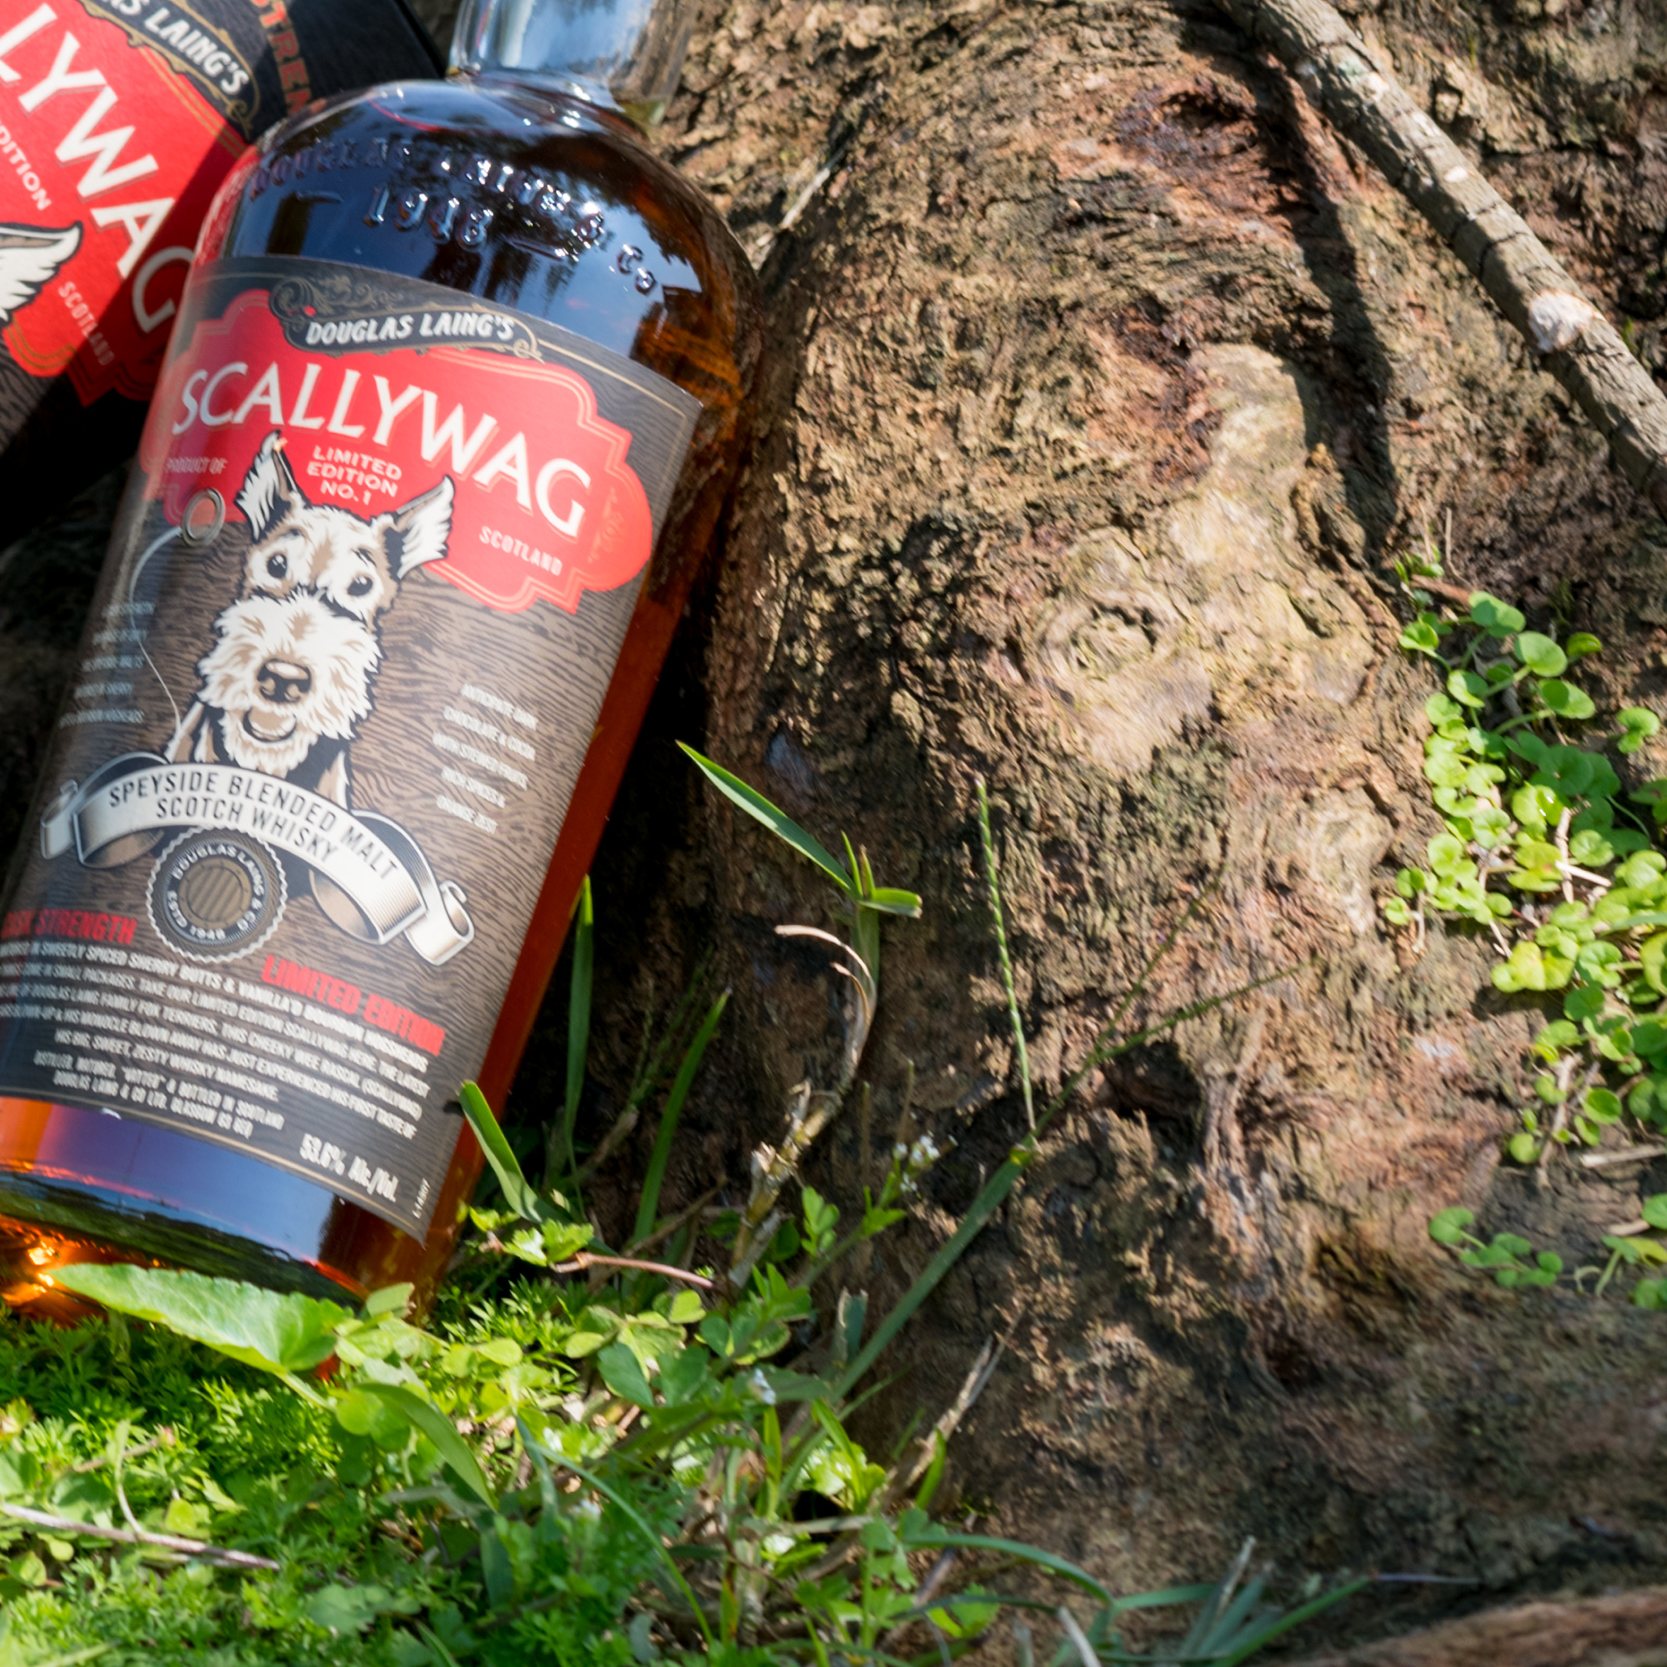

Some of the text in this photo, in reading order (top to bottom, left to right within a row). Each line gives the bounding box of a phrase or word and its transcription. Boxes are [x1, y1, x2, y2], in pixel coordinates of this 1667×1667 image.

[144, 7, 249, 95] LAING'S
[57, 280, 116, 366] SCOTLAND
[306, 311, 515, 346] DOUGLAS LAING'S
[172, 361, 592, 538] SCALLYWAG
[312, 445, 402, 481] LIMITED
[306, 460, 398, 498] EDITION
[478, 525, 563, 577] SCOTLAND
[108, 770, 399, 881] SPEYSIDE BLENDED MALT
[155, 797, 339, 864] SCOTCH WHISKY
[171, 844, 238, 881] DOUGLAS
[36, 908, 138, 947] STRENGTH
[84, 945, 128, 966] SPICED
[126, 952, 179, 977] SHERRY
[178, 964, 224, 990] BUTTS
[221, 976, 239, 993] &
[234, 980, 305, 1016] VANILLA'D
[189, 990, 240, 1017] LIMITED
[235, 1004, 286, 1033] EDITION
[261, 954, 446, 1056] LIMITED EDITION
[218, 1022, 250, 1044] THIS
[245, 1031, 296, 1060] CHEEKY
[299, 1132, 347, 1176] 53.6%
